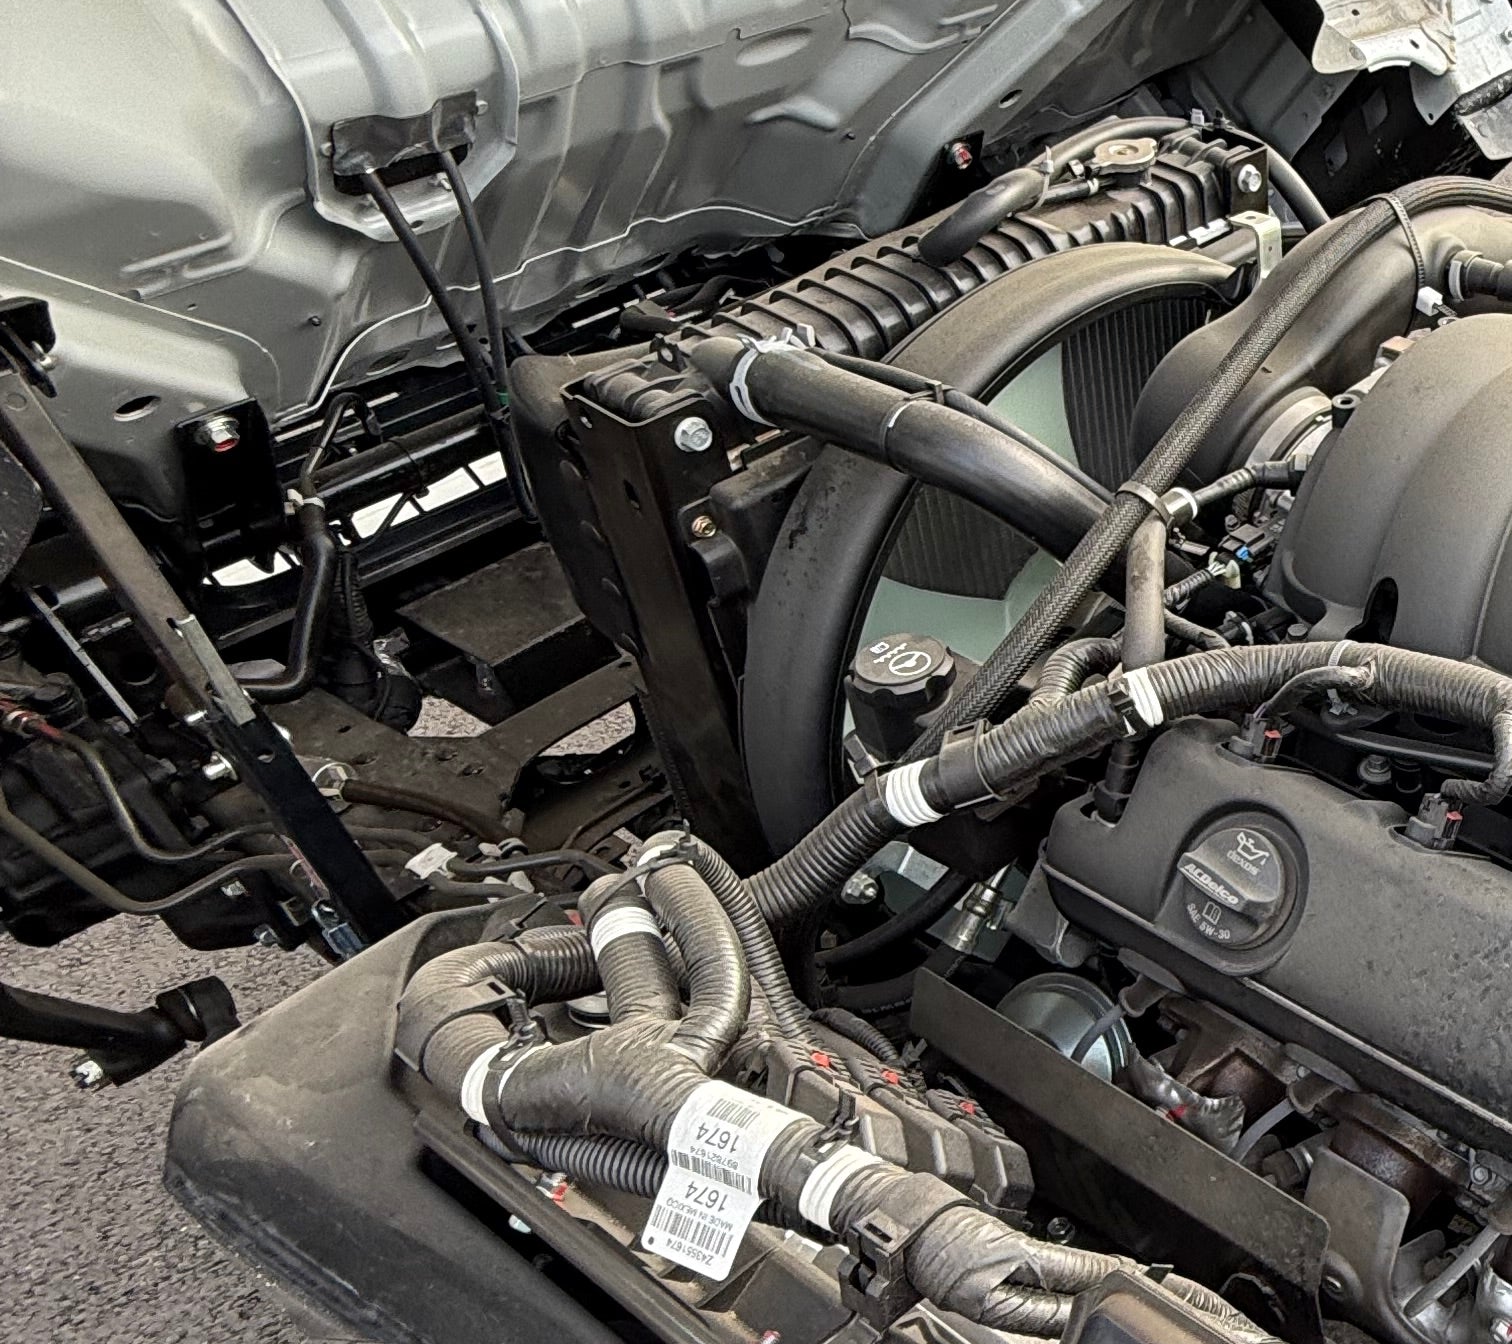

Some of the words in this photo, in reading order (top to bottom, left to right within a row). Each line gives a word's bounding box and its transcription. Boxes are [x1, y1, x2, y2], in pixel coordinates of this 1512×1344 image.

[1227, 849, 1259, 876] dexos
[1184, 863, 1239, 905] ACDelco
[1187, 903, 1201, 923] SAE
[1199, 921, 1231, 939] 5W-30
[696, 1122, 740, 1153] 1674
[666, 1197, 697, 1217] MEXICO
[685, 1181, 728, 1212] 1674
[698, 1212, 708, 1221] IN
[708, 1216, 734, 1232] MADE
[666, 1238, 715, 1267] Z43551674
